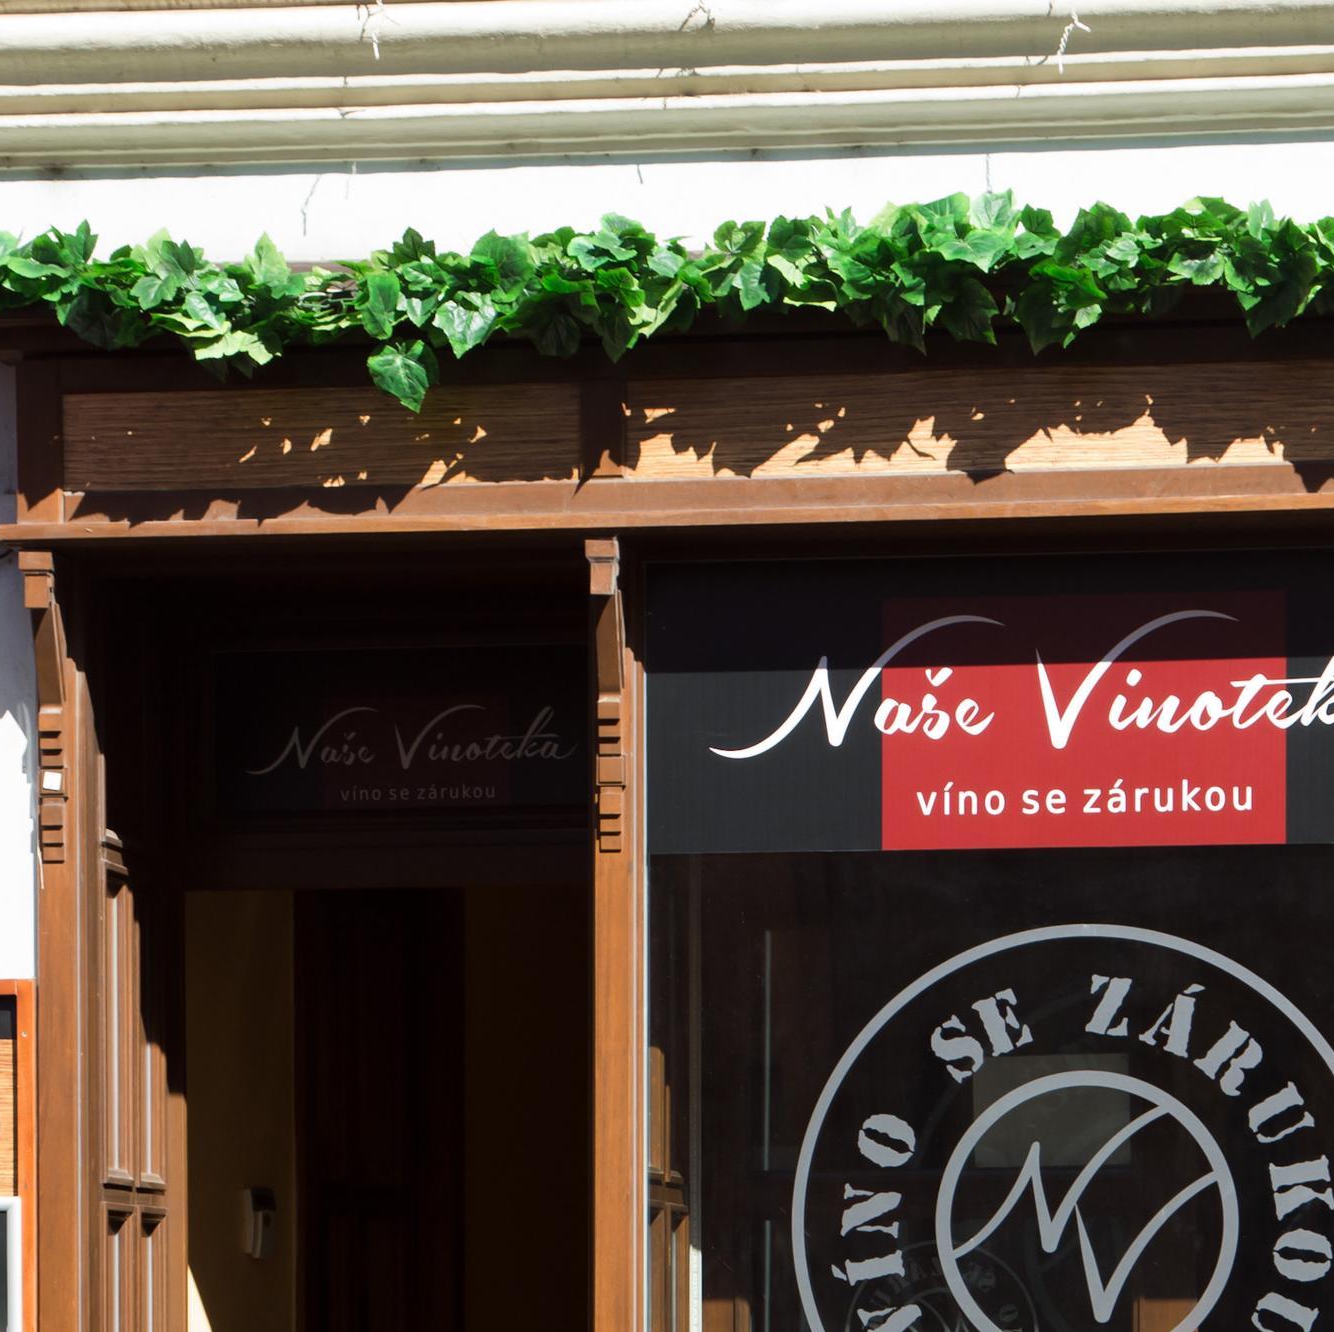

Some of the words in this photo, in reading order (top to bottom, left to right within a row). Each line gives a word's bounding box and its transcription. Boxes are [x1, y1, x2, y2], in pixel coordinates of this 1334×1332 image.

[708, 614, 1006, 760] Naše
[244, 706, 379, 775] Naše
[394, 704, 579, 770] Vinoteka
[340, 784, 382, 801] víno
[389, 787, 410, 801] se
[417, 783, 496, 801] zárukou
[916, 780, 1007, 816] víno
[1021, 787, 1068, 815] se
[1083, 778, 1254, 815] zárukou
[930, 988, 1034, 1083] SE
